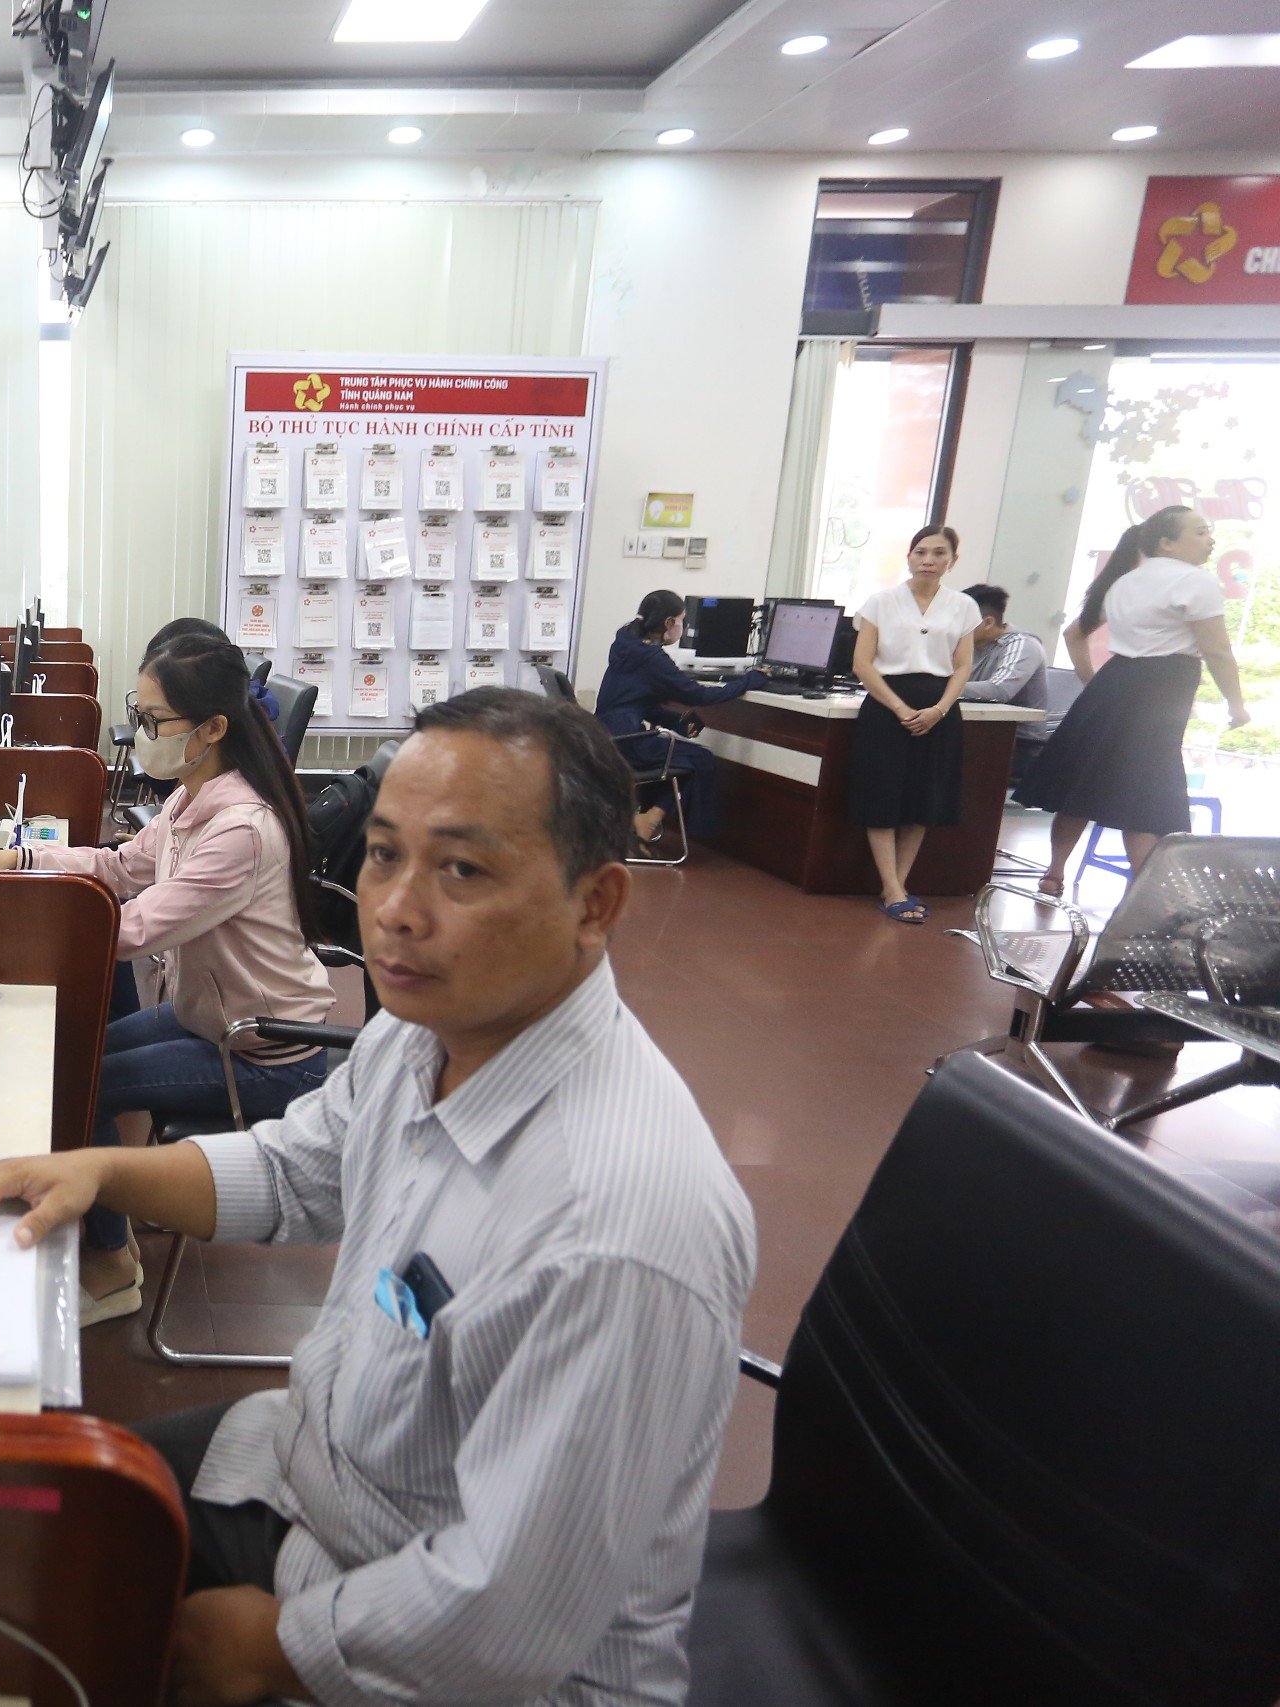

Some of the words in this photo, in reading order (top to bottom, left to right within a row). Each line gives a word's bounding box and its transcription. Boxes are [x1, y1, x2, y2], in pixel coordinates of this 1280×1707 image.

[1243, 246, 1280, 275] CH
[339, 376, 369, 388] TRUNG
[370, 376, 387, 388] TÂM
[388, 377, 414, 389] PHỤC
[415, 377, 428, 390] VỤ
[428, 377, 454, 389] HÀNH
[454, 377, 483, 389] CHÍNH
[483, 378, 509, 390] CÔNG
[393, 390, 414, 401] NAM
[339, 402, 359, 410] Hành
[361, 402, 383, 411] chính
[248, 415, 274, 438] BỘ
[279, 414, 318, 434] THỦ
[322, 419, 360, 438] TỤC
[365, 417, 418, 436] HÀNH
[424, 418, 484, 436] CHÍNH
[489, 417, 525, 437] CẤP
[529, 418, 575, 438] TỈNH
